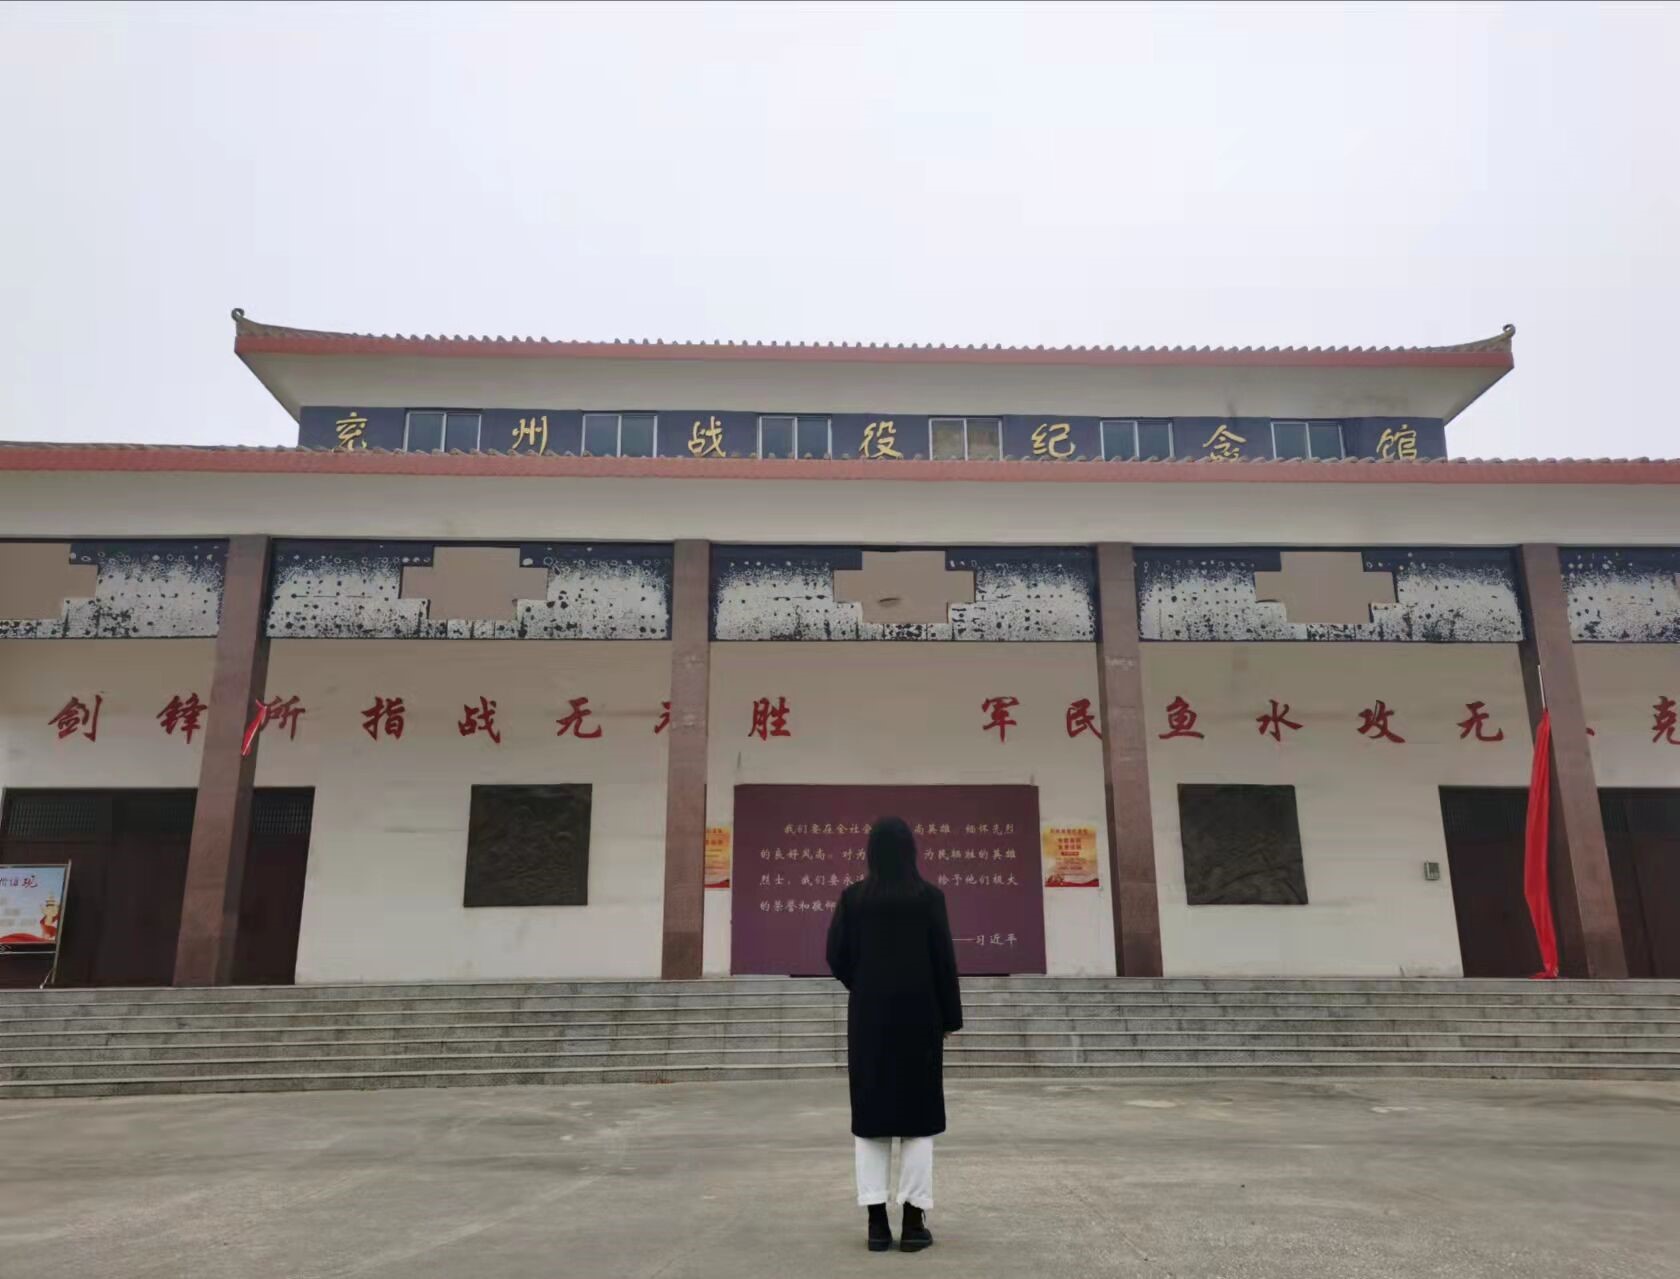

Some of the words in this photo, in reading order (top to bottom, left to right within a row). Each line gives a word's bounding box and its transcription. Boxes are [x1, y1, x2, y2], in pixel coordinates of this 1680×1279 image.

[333, 411, 1420, 459] 兖州战役纪念馆
[981, 695, 1680, 745] 军民鱼水攻无克
[937, 872, 1019, 886] 给予他们极大
